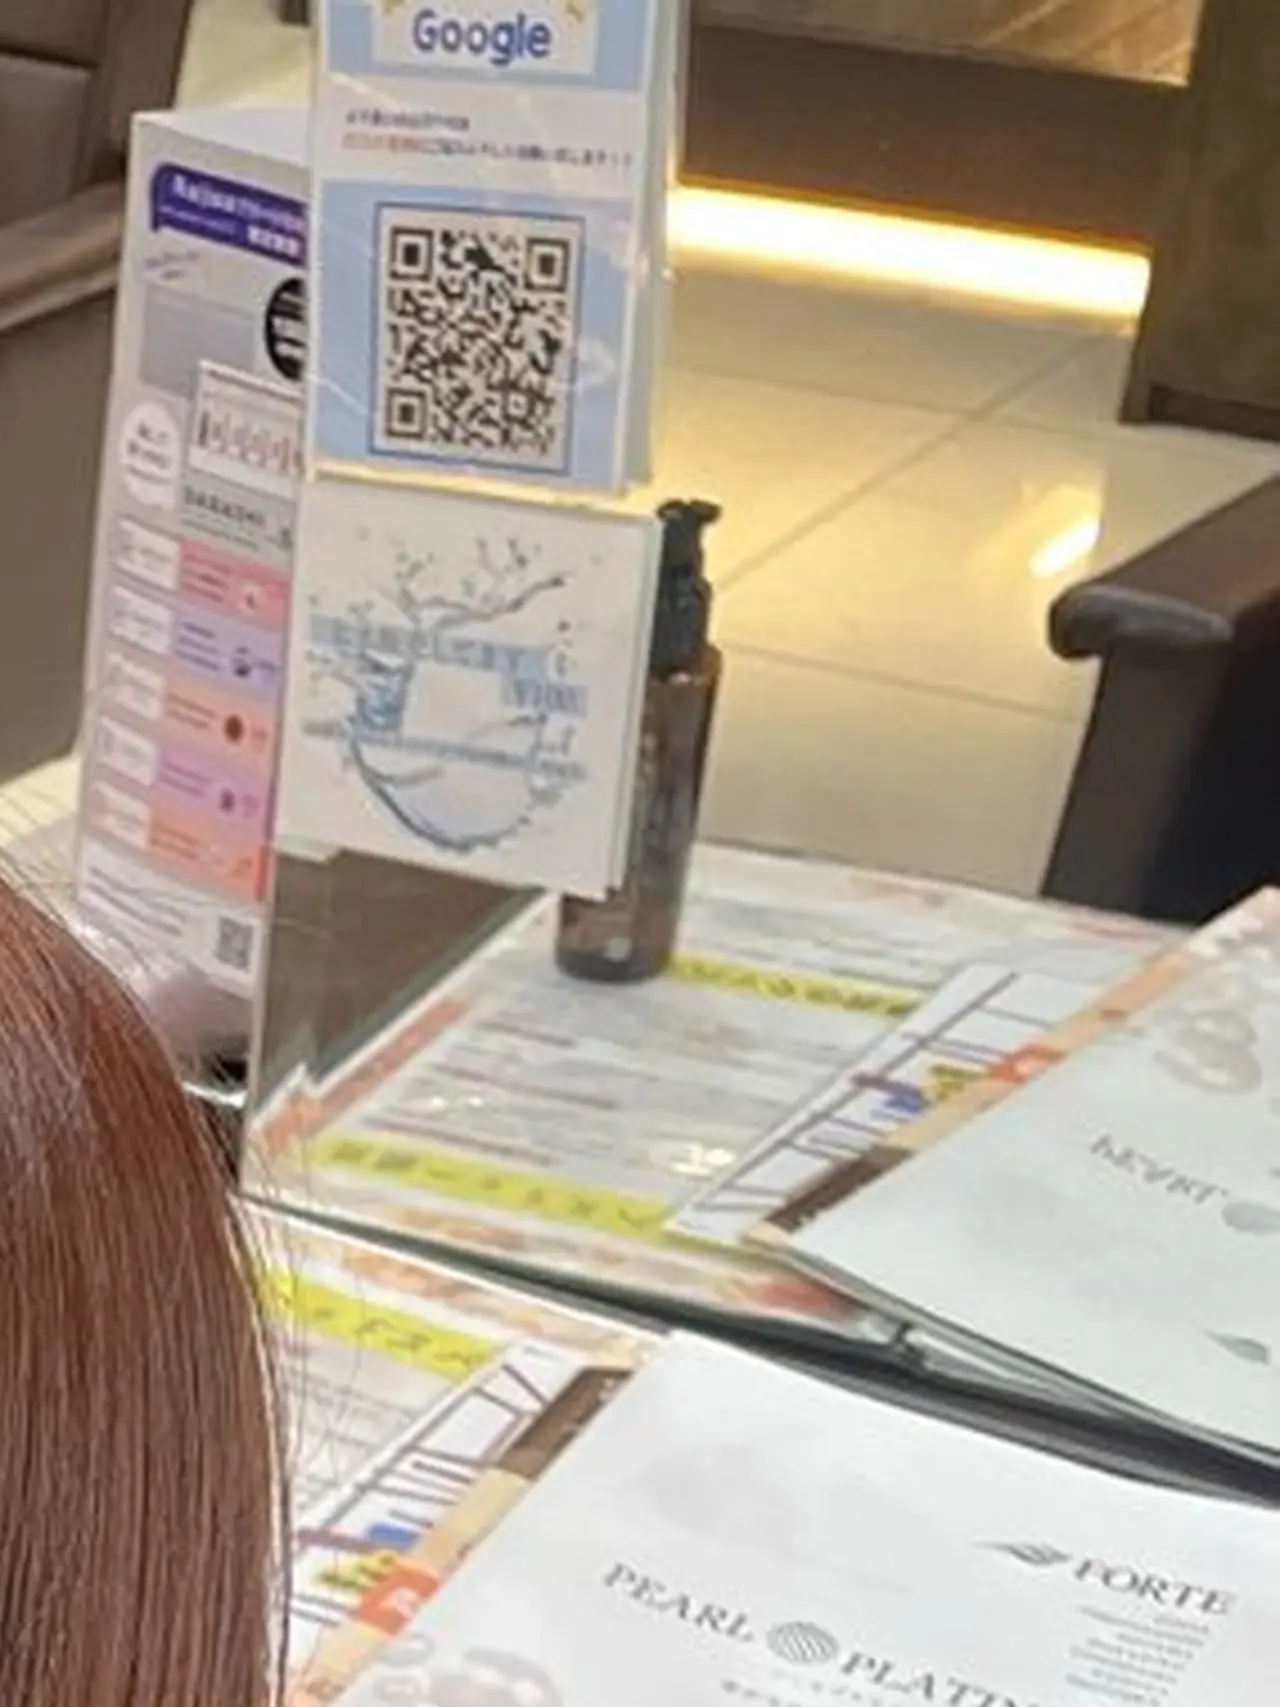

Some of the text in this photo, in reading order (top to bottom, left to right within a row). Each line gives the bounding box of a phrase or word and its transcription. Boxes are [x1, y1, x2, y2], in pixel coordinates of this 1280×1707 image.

[412, 9, 551, 66] Google
[602, 1562, 755, 1643] PEARL
[1073, 1556, 1238, 1616] FORTE
